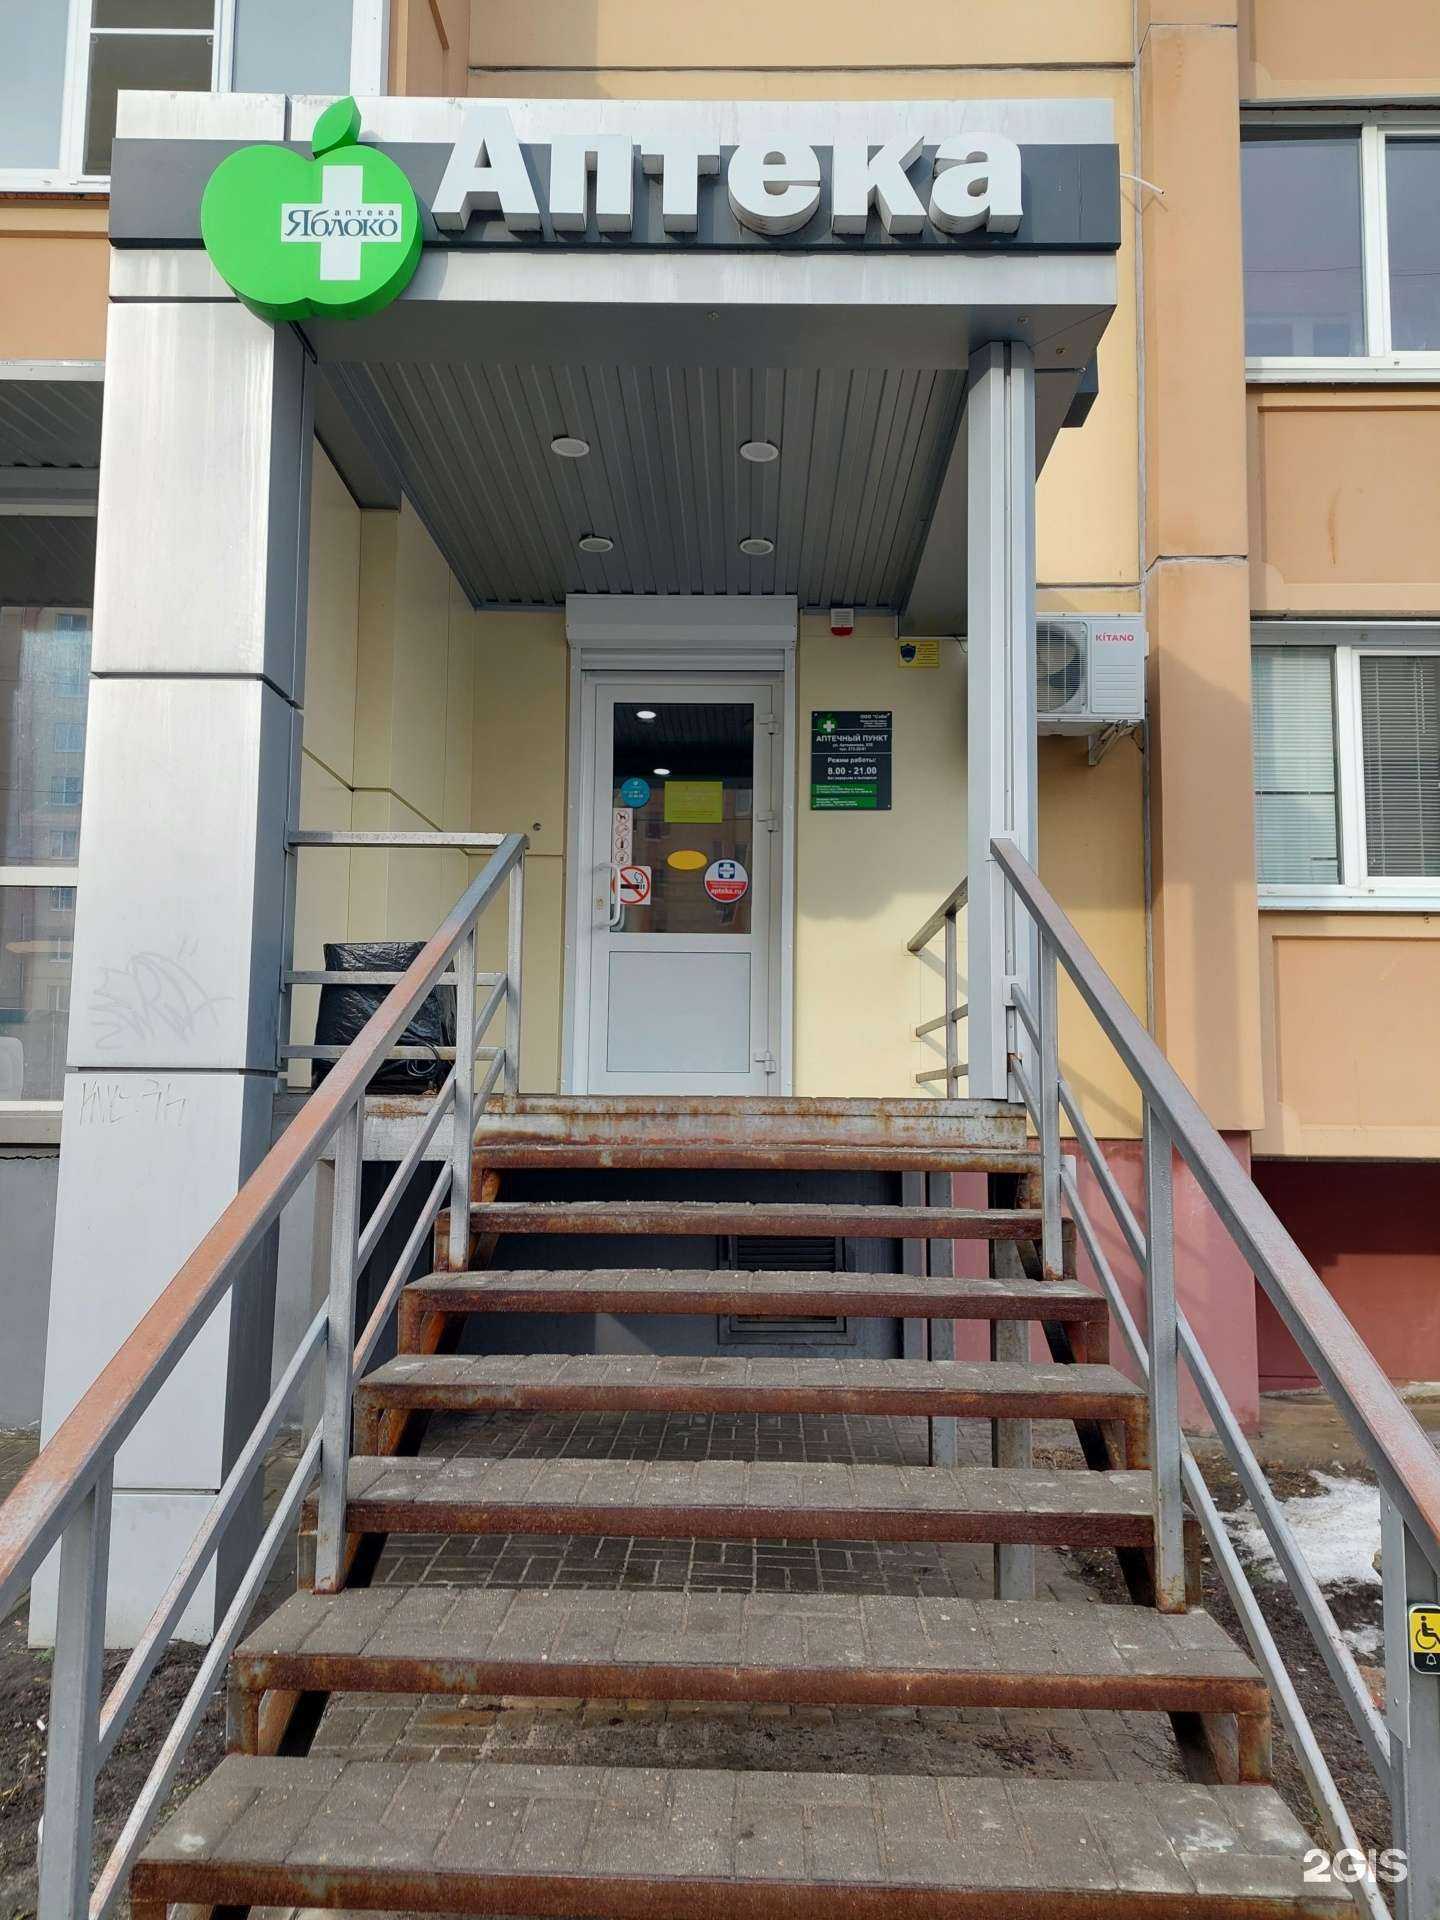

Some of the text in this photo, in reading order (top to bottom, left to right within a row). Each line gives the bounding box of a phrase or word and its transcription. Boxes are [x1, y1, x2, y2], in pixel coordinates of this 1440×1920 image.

[432, 106, 1024, 236] Аптека
[334, 208, 395, 216] аптека
[284, 209, 398, 237] Яблоко
[816, 733, 888, 742] АПТЕЧНЫЙ ПУНКТ
[827, 767, 846, 775] 8.00
[853, 766, 877, 775] 21.00
